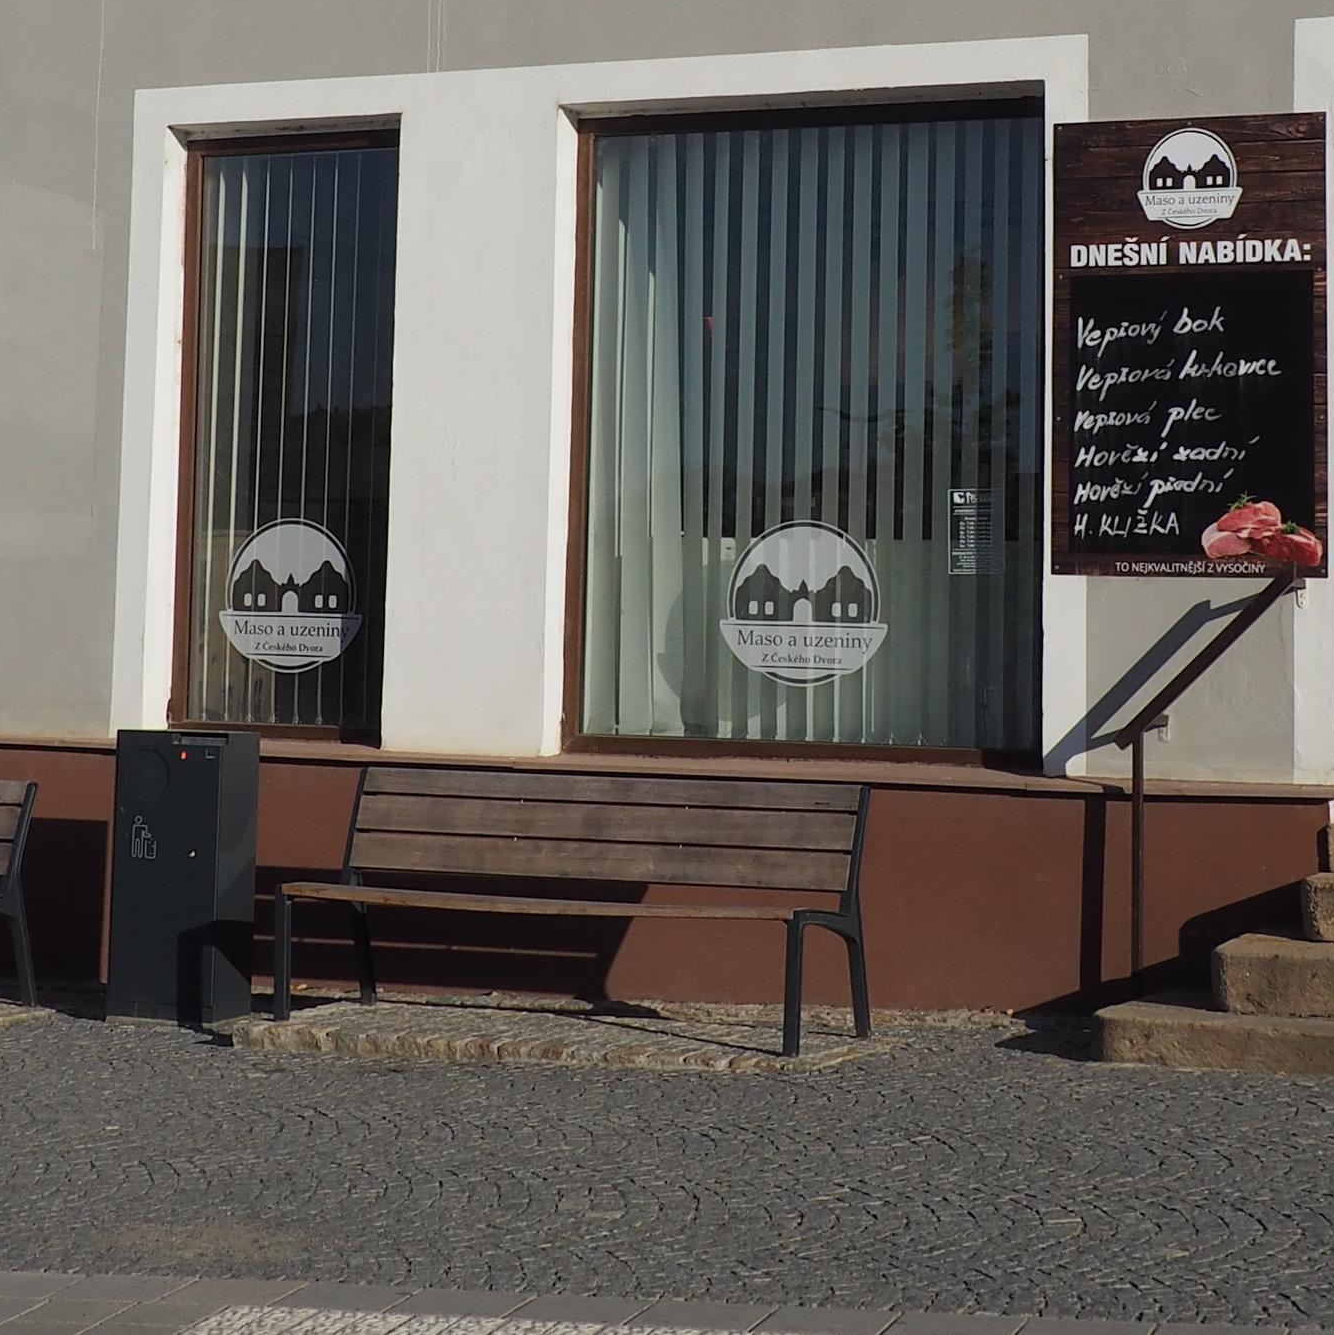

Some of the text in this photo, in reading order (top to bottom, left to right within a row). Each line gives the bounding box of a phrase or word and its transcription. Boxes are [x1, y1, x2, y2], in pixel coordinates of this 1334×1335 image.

[1145, 193, 1235, 206] Maso a uzeniny
[1070, 233, 1312, 268] DNEŠNÍ NABÍDKA:
[1173, 306, 1226, 334] bok
[1161, 398, 1223, 438] plec
[1115, 560, 1266, 575] TO NEJKVALITNĚJŠÍ Z VYSOČINY
[234, 619, 350, 643] Maso a uzeniny
[737, 629, 873, 655] Maso a uzeniny
[262, 641, 297, 652] Českého
[298, 643, 324, 652] Dvora
[761, 651, 842, 665] Z Českého Dvora
